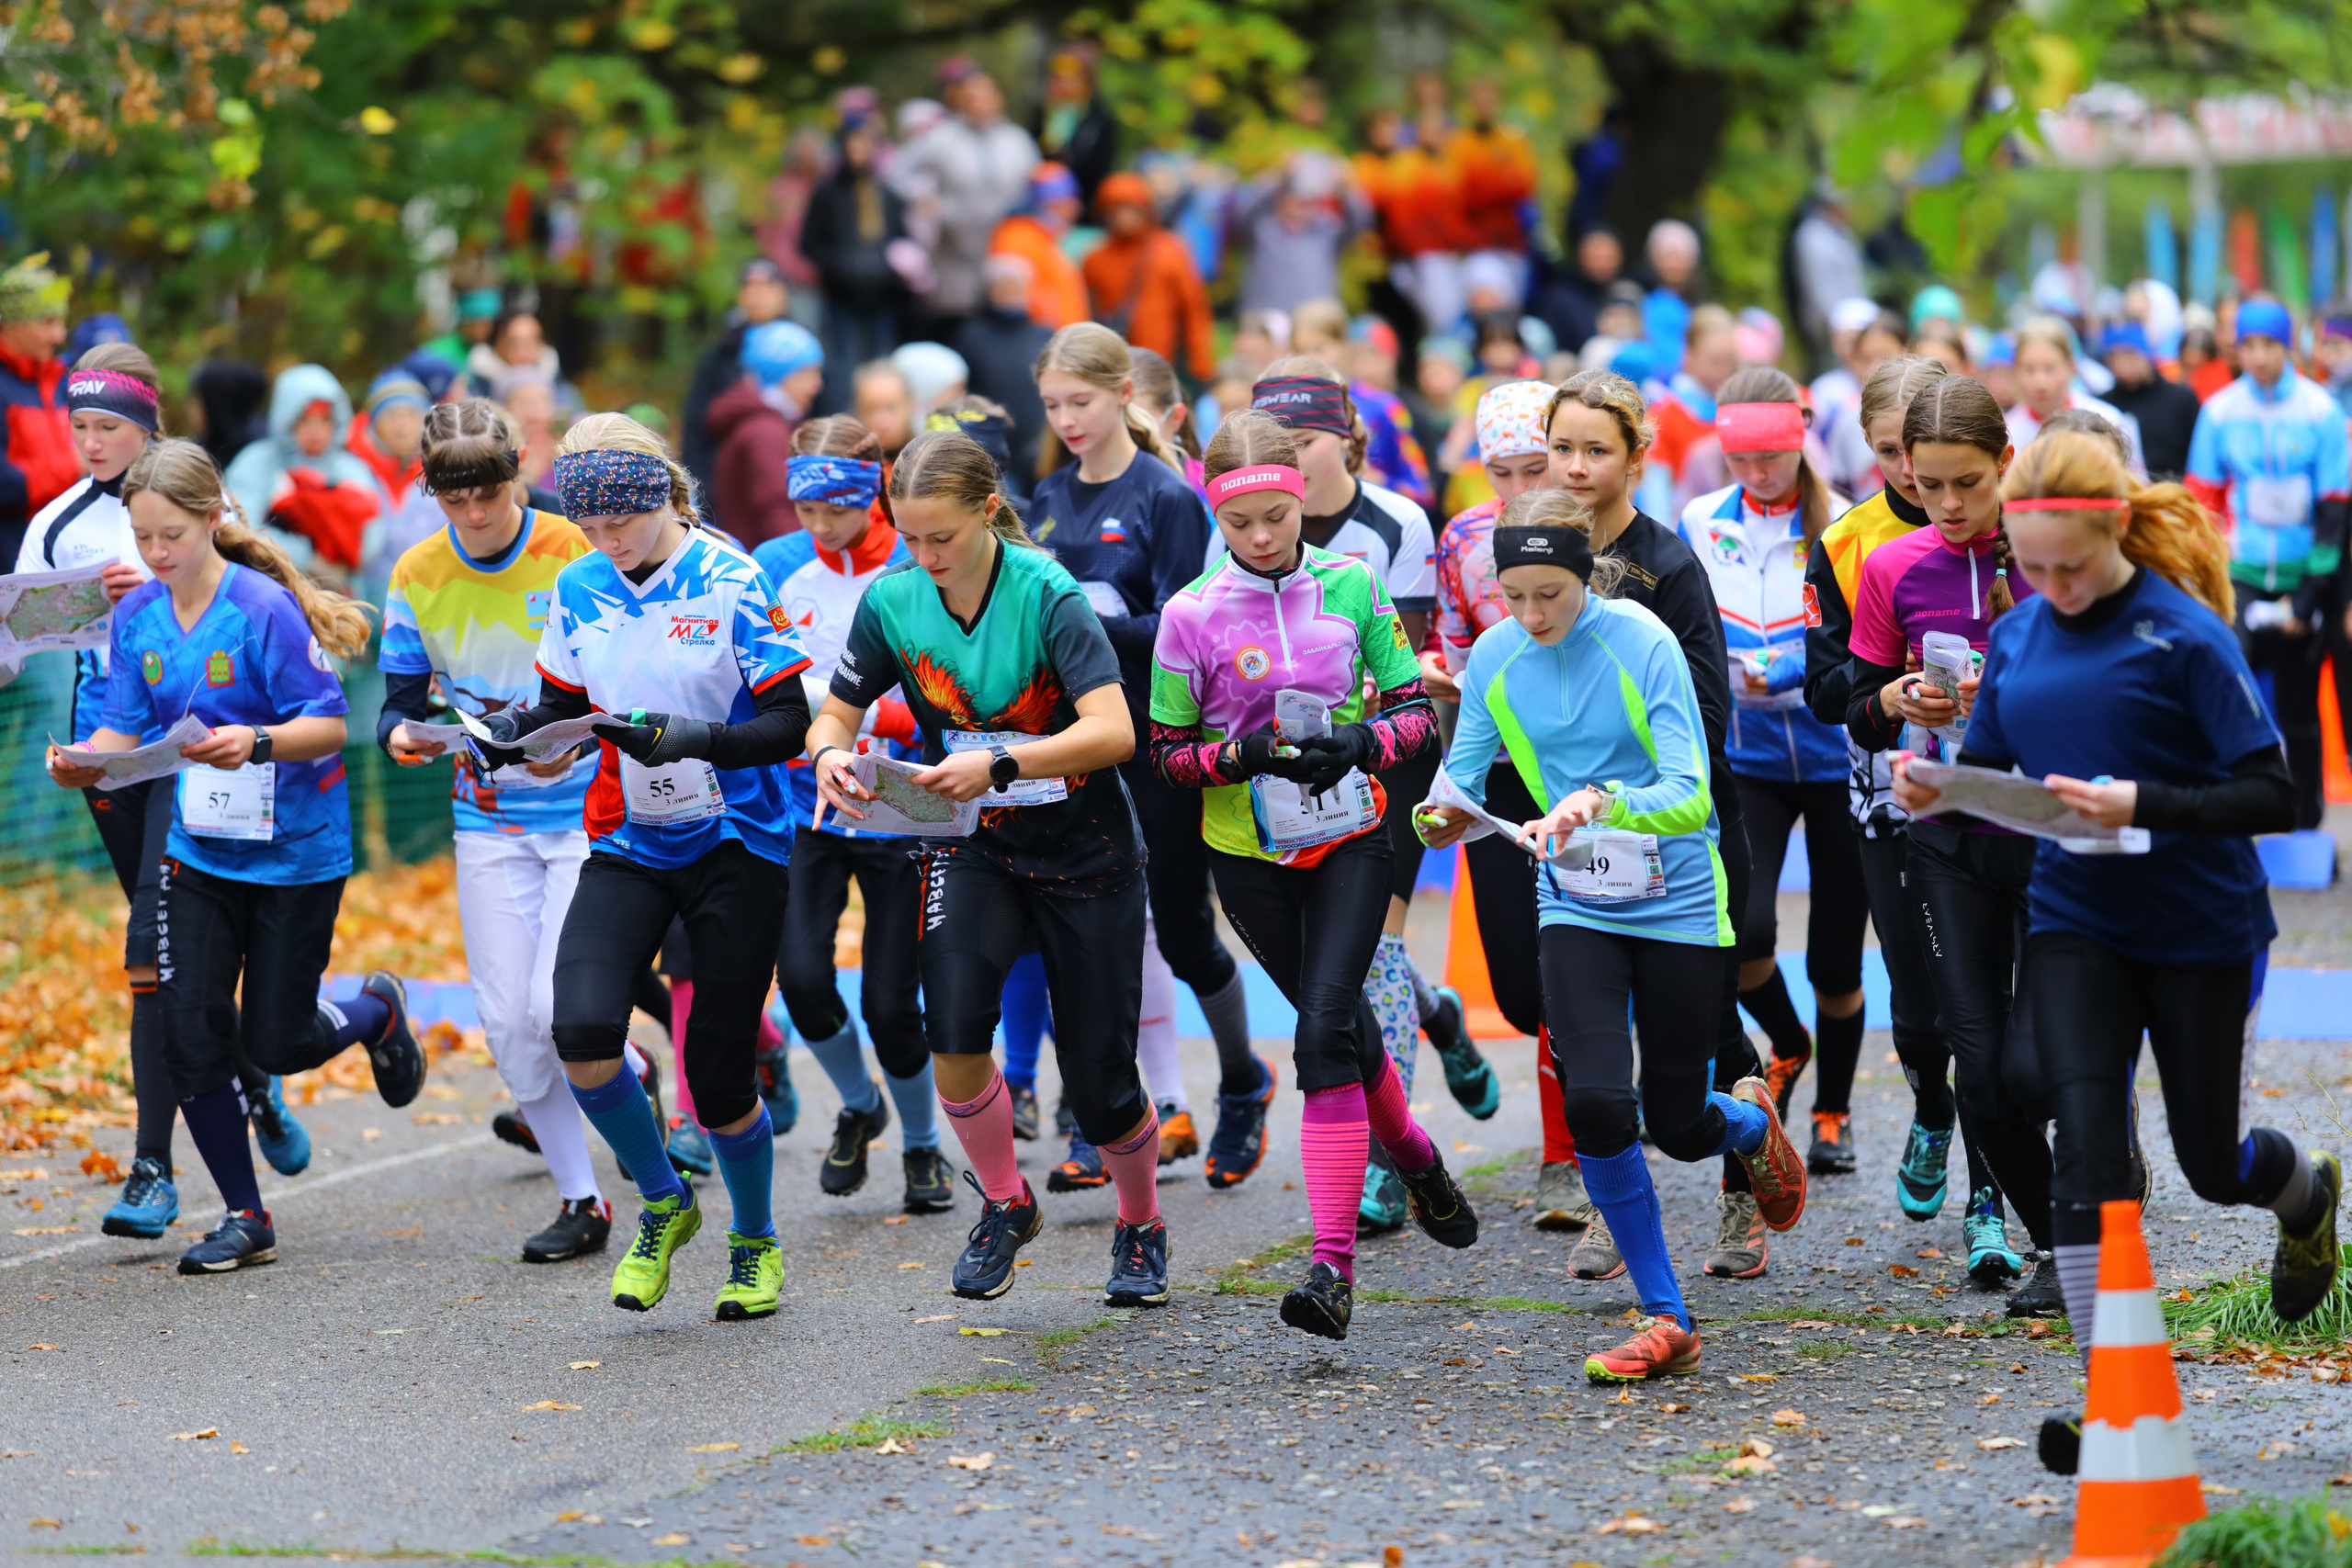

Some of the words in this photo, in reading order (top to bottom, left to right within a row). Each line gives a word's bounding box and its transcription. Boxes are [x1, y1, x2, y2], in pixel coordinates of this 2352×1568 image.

[1220, 472, 1281, 492] noname
[1914, 608, 1961, 618] noname
[671, 615, 719, 625] Магнитная
[680, 637, 716, 647] Стрелка
[650, 778, 675, 798] 55
[209, 793, 231, 809] 57
[665, 798, 671, 807] 3
[673, 794, 699, 805] линия
[1323, 811, 1349, 821] линия
[1274, 837, 1306, 845] ПЕРВЕНСТВО
[1306, 832, 1326, 840] РОССИИ
[1275, 840, 1316, 850] ВСЕРОССИЙСКИЕ
[1317, 829, 1354, 843] СОРЕВНОВАНИЯ
[1585, 856, 1610, 875] 49
[1598, 879, 1602, 887] 3
